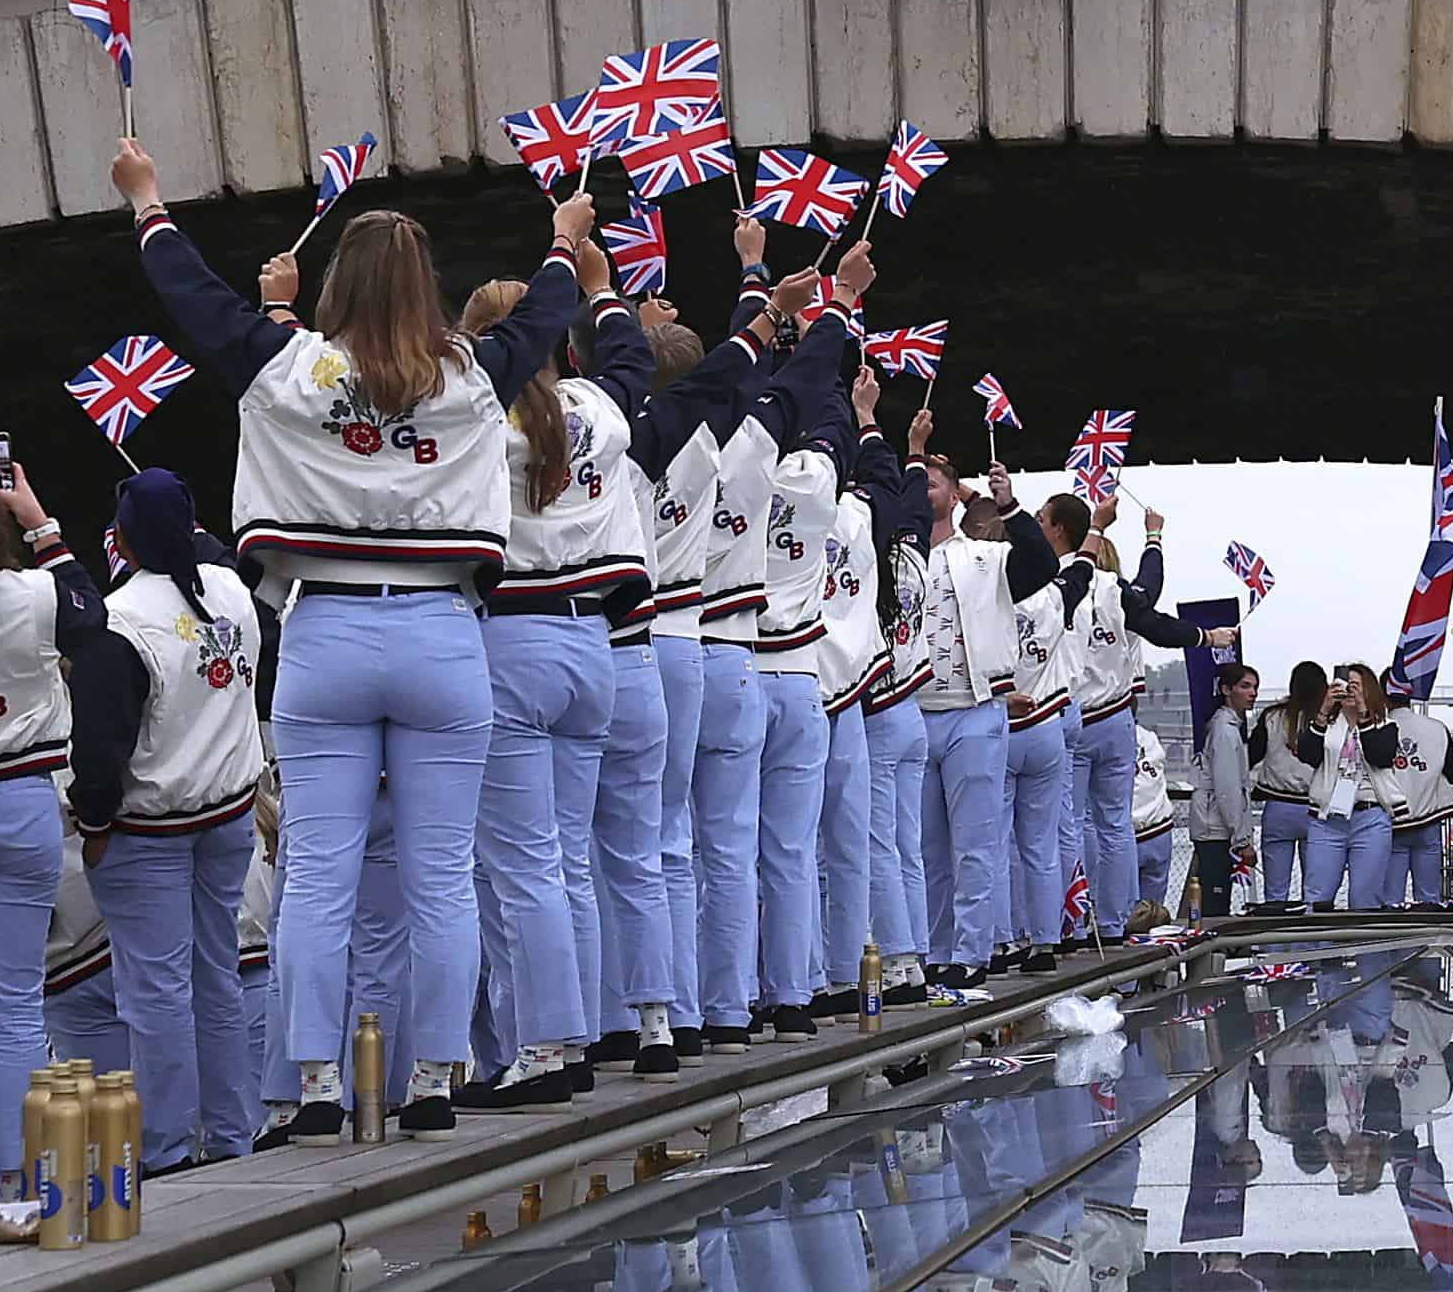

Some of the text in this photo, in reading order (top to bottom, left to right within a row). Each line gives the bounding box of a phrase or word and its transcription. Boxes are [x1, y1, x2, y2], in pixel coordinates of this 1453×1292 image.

[391, 425, 439, 464] GB
[577, 461, 603, 500] GB
[659, 499, 688, 527] GB
[713, 510, 748, 536] GB
[775, 532, 804, 560] GB
[839, 571, 860, 597] GB
[1093, 627, 1116, 645] GB
[1026, 640, 1048, 663] GB
[237, 654, 253, 688] GB
[1142, 760, 1158, 777] GB
